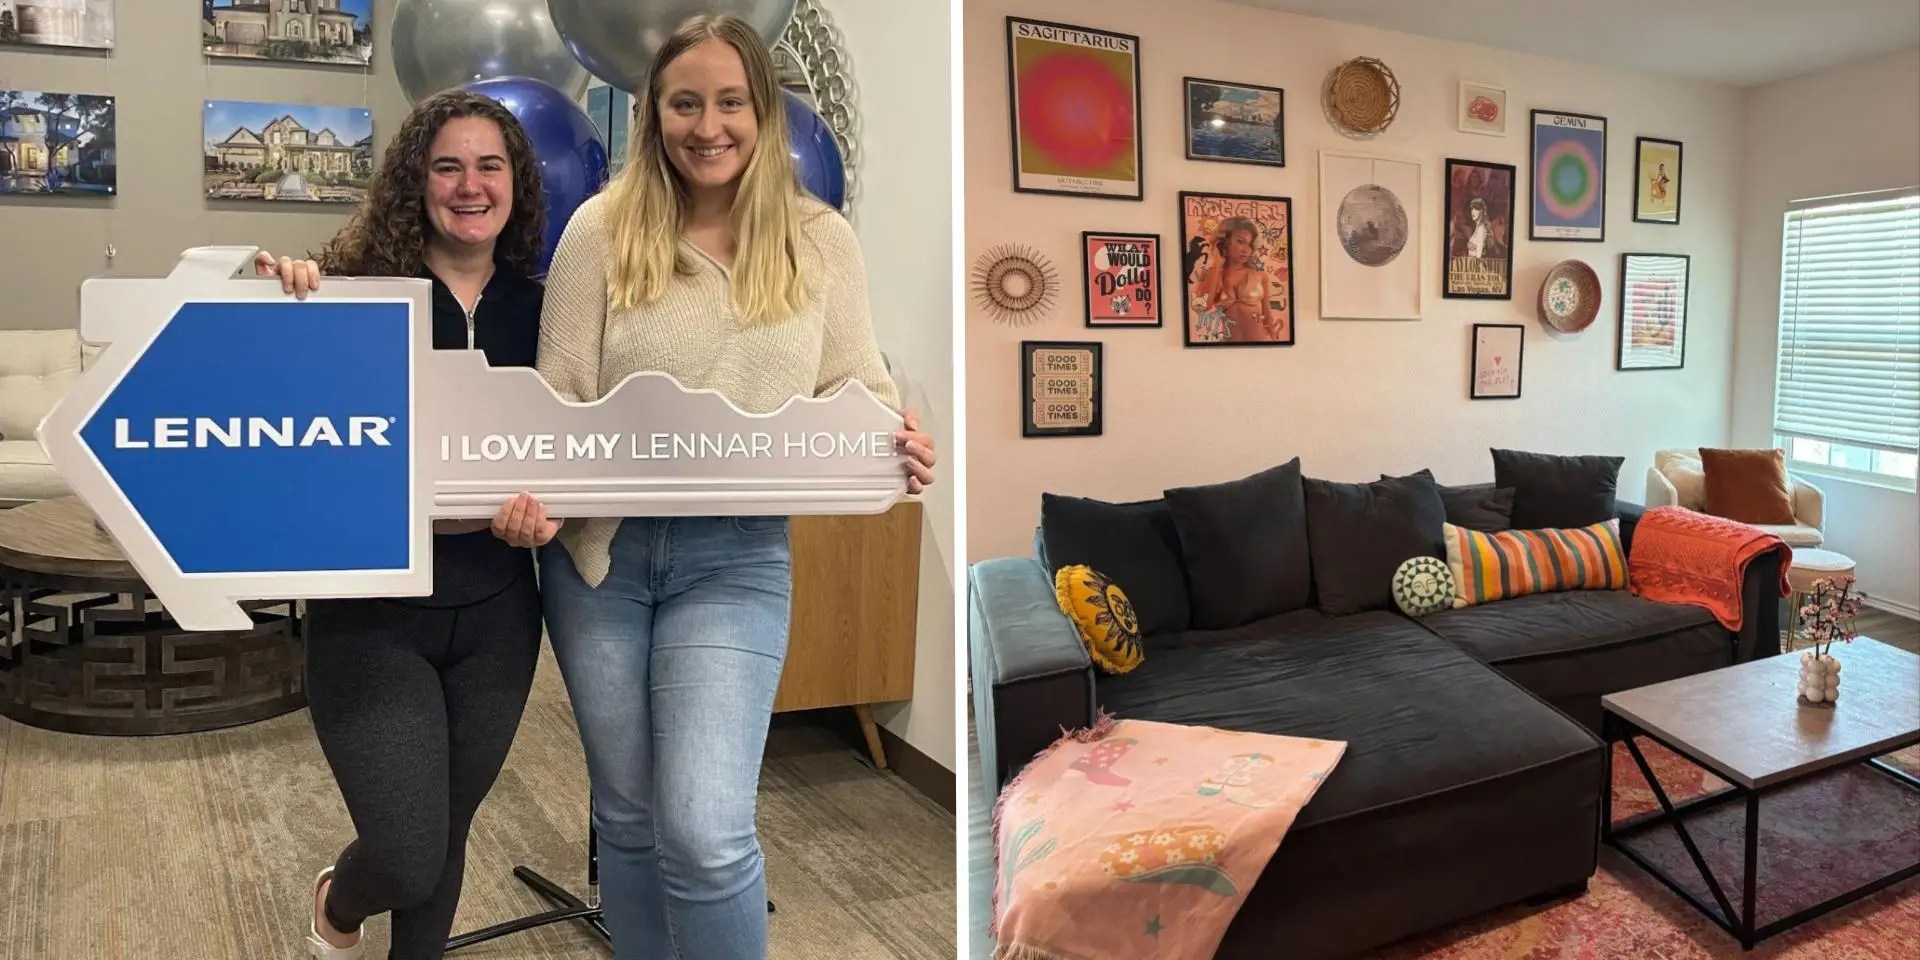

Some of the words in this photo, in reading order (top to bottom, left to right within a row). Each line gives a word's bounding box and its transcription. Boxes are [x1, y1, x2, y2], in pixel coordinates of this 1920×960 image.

[1018, 24, 1129, 51] SAGITTARIUS
[1553, 115, 1587, 128] GEMINI
[1104, 243, 1150, 253] WHAT
[1107, 253, 1151, 267] WOULD
[1095, 268, 1150, 296] Dolly
[1136, 288, 1152, 301] DO
[1145, 302, 1152, 315] ?
[1047, 355, 1077, 363] GOOD
[1047, 363, 1078, 371] TIMES
[1047, 387, 1078, 395] TIMES
[1047, 412, 1078, 420] TIMES
[441, 435, 450, 461] I
[461, 434, 555, 461] LOVE
[566, 433, 621, 460] MY
[631, 432, 773, 459] LENNAR
